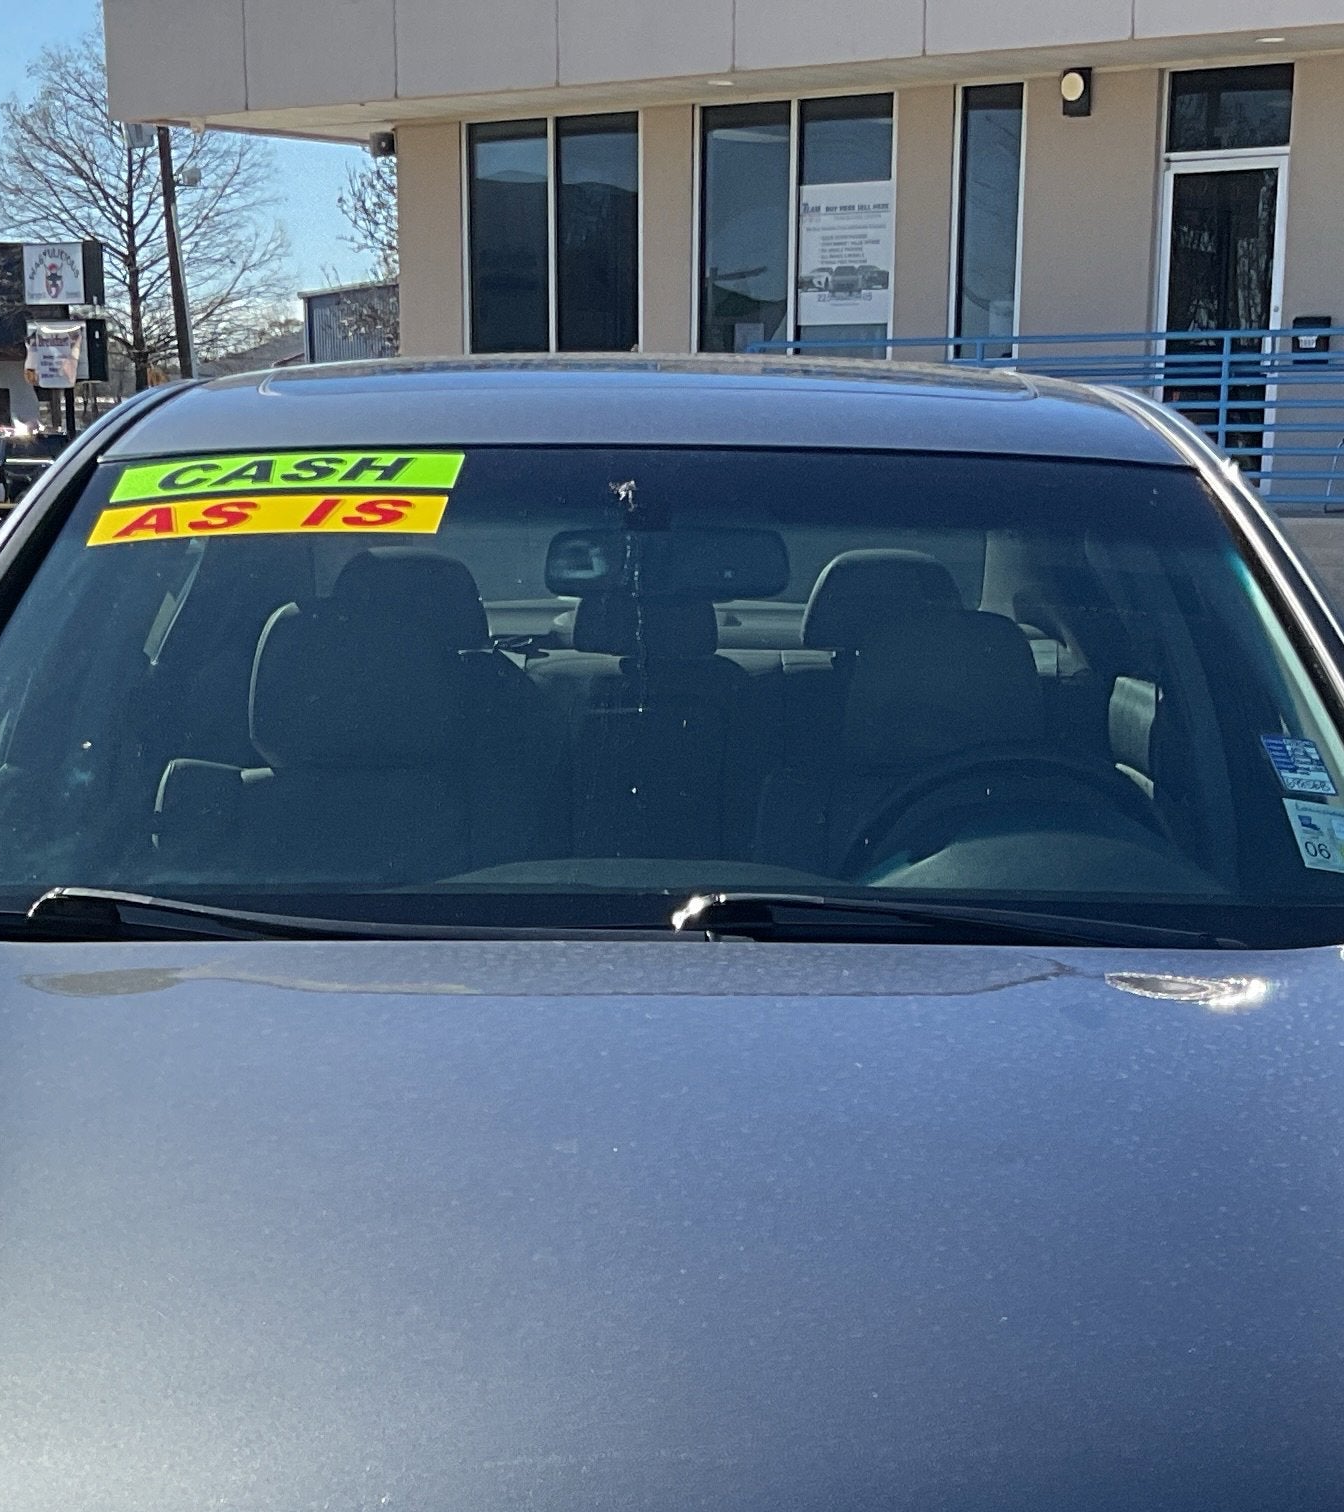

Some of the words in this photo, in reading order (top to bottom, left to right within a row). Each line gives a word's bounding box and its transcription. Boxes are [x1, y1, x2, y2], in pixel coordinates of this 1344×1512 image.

[157, 456, 418, 492] CASH
[112, 500, 261, 539] AS
[300, 498, 416, 529] IS
[1304, 841, 1331, 860] 06
